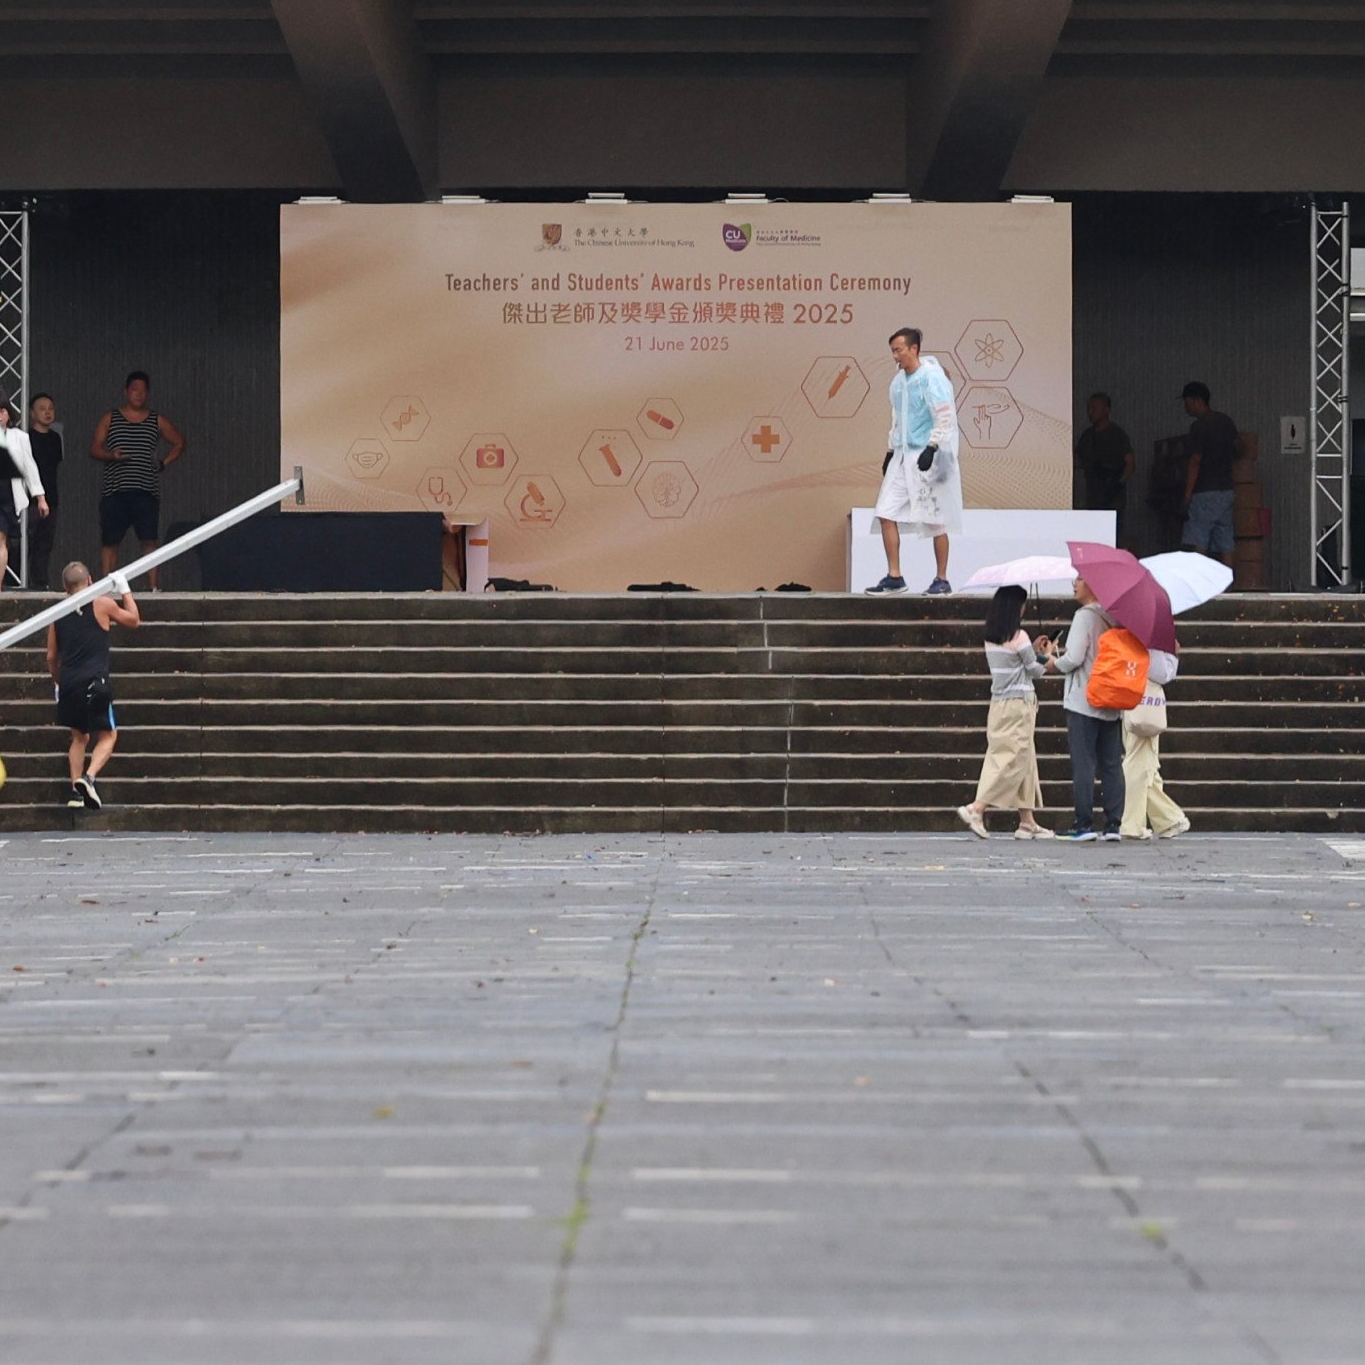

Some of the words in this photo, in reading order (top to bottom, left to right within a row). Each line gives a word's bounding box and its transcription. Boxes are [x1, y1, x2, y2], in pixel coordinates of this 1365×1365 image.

[575, 227, 649, 237] 香港中文大學
[725, 230, 741, 239] CU
[574, 239, 586, 247] The
[587, 239, 613, 247] Chinese
[656, 239, 677, 248] Hong
[677, 239, 695, 248] Kong
[445, 273, 525, 291] Teachers'
[531, 273, 560, 291] and
[567, 273, 645, 291] Students'
[651, 273, 712, 291] Awards
[718, 273, 823, 291] Presentation
[830, 273, 911, 295] Ceremony
[793, 303, 854, 324] 2025
[625, 337, 642, 351] 21
[649, 337, 684, 351] June
[690, 337, 729, 351] 2025
